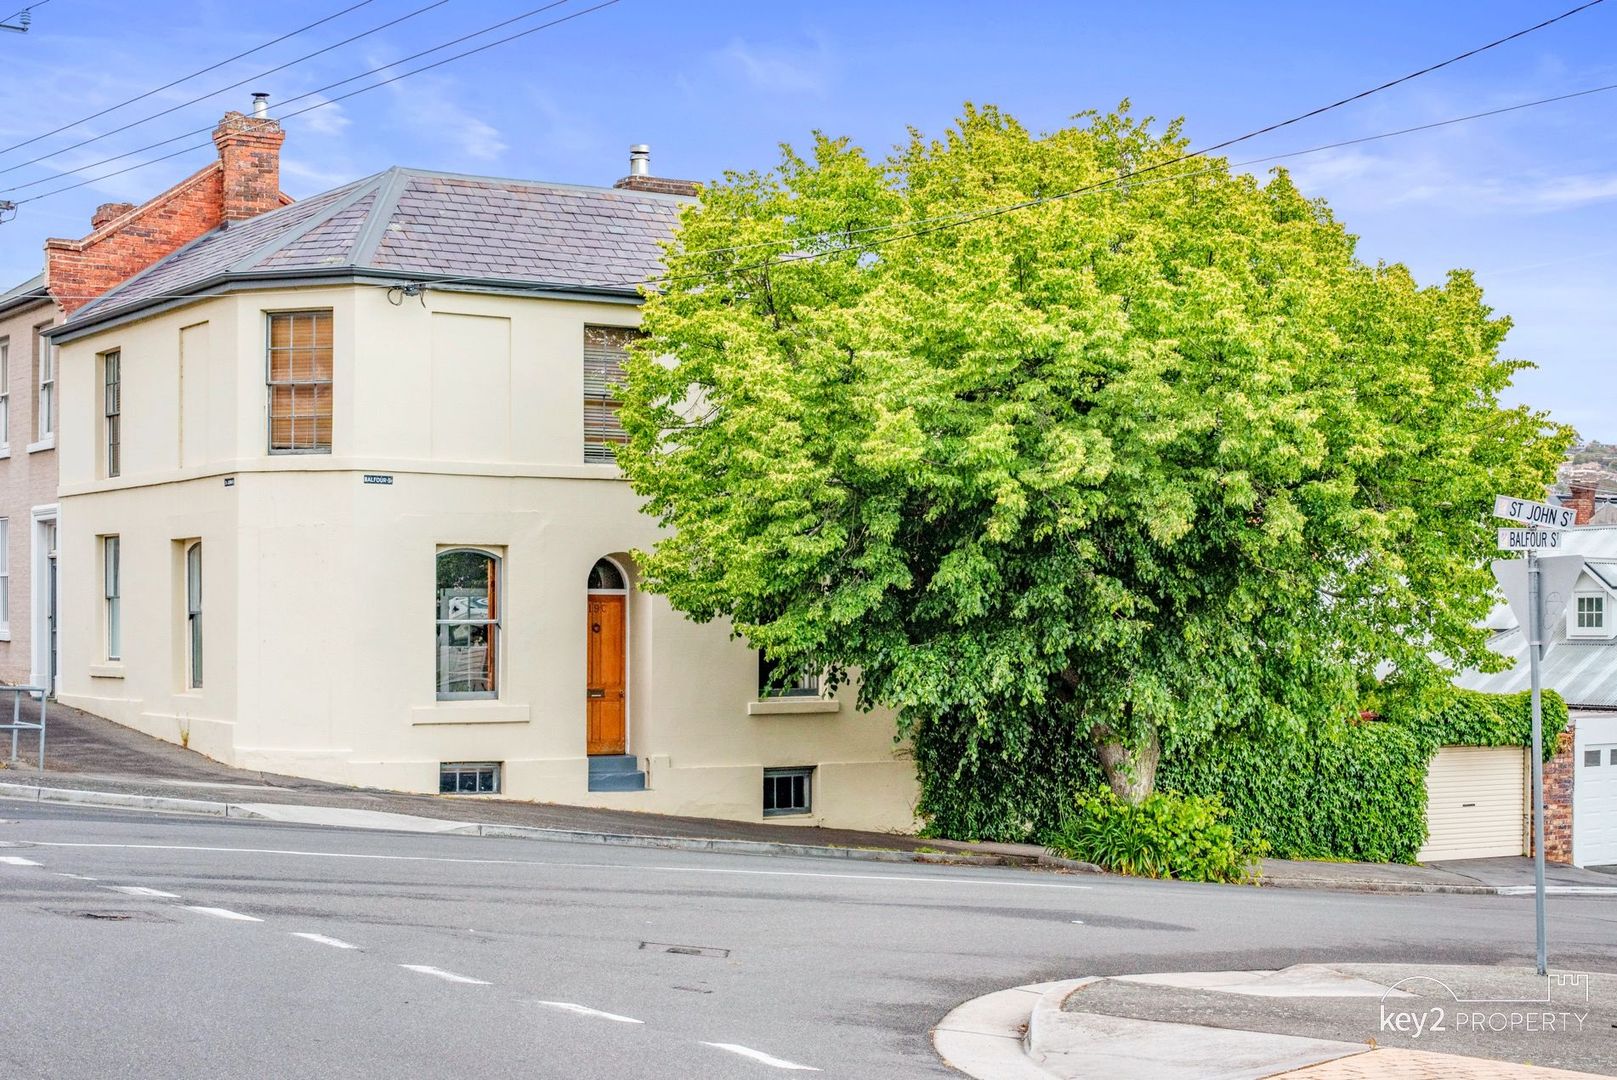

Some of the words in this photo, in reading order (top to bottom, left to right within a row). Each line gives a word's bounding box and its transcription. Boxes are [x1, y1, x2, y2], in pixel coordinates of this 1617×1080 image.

[1509, 501, 1524, 518] ST
[1526, 505, 1558, 525] JOHN
[1560, 511, 1574, 527] ST
[1509, 531, 1547, 548] BALFOUR
[1550, 532, 1560, 548] ST
